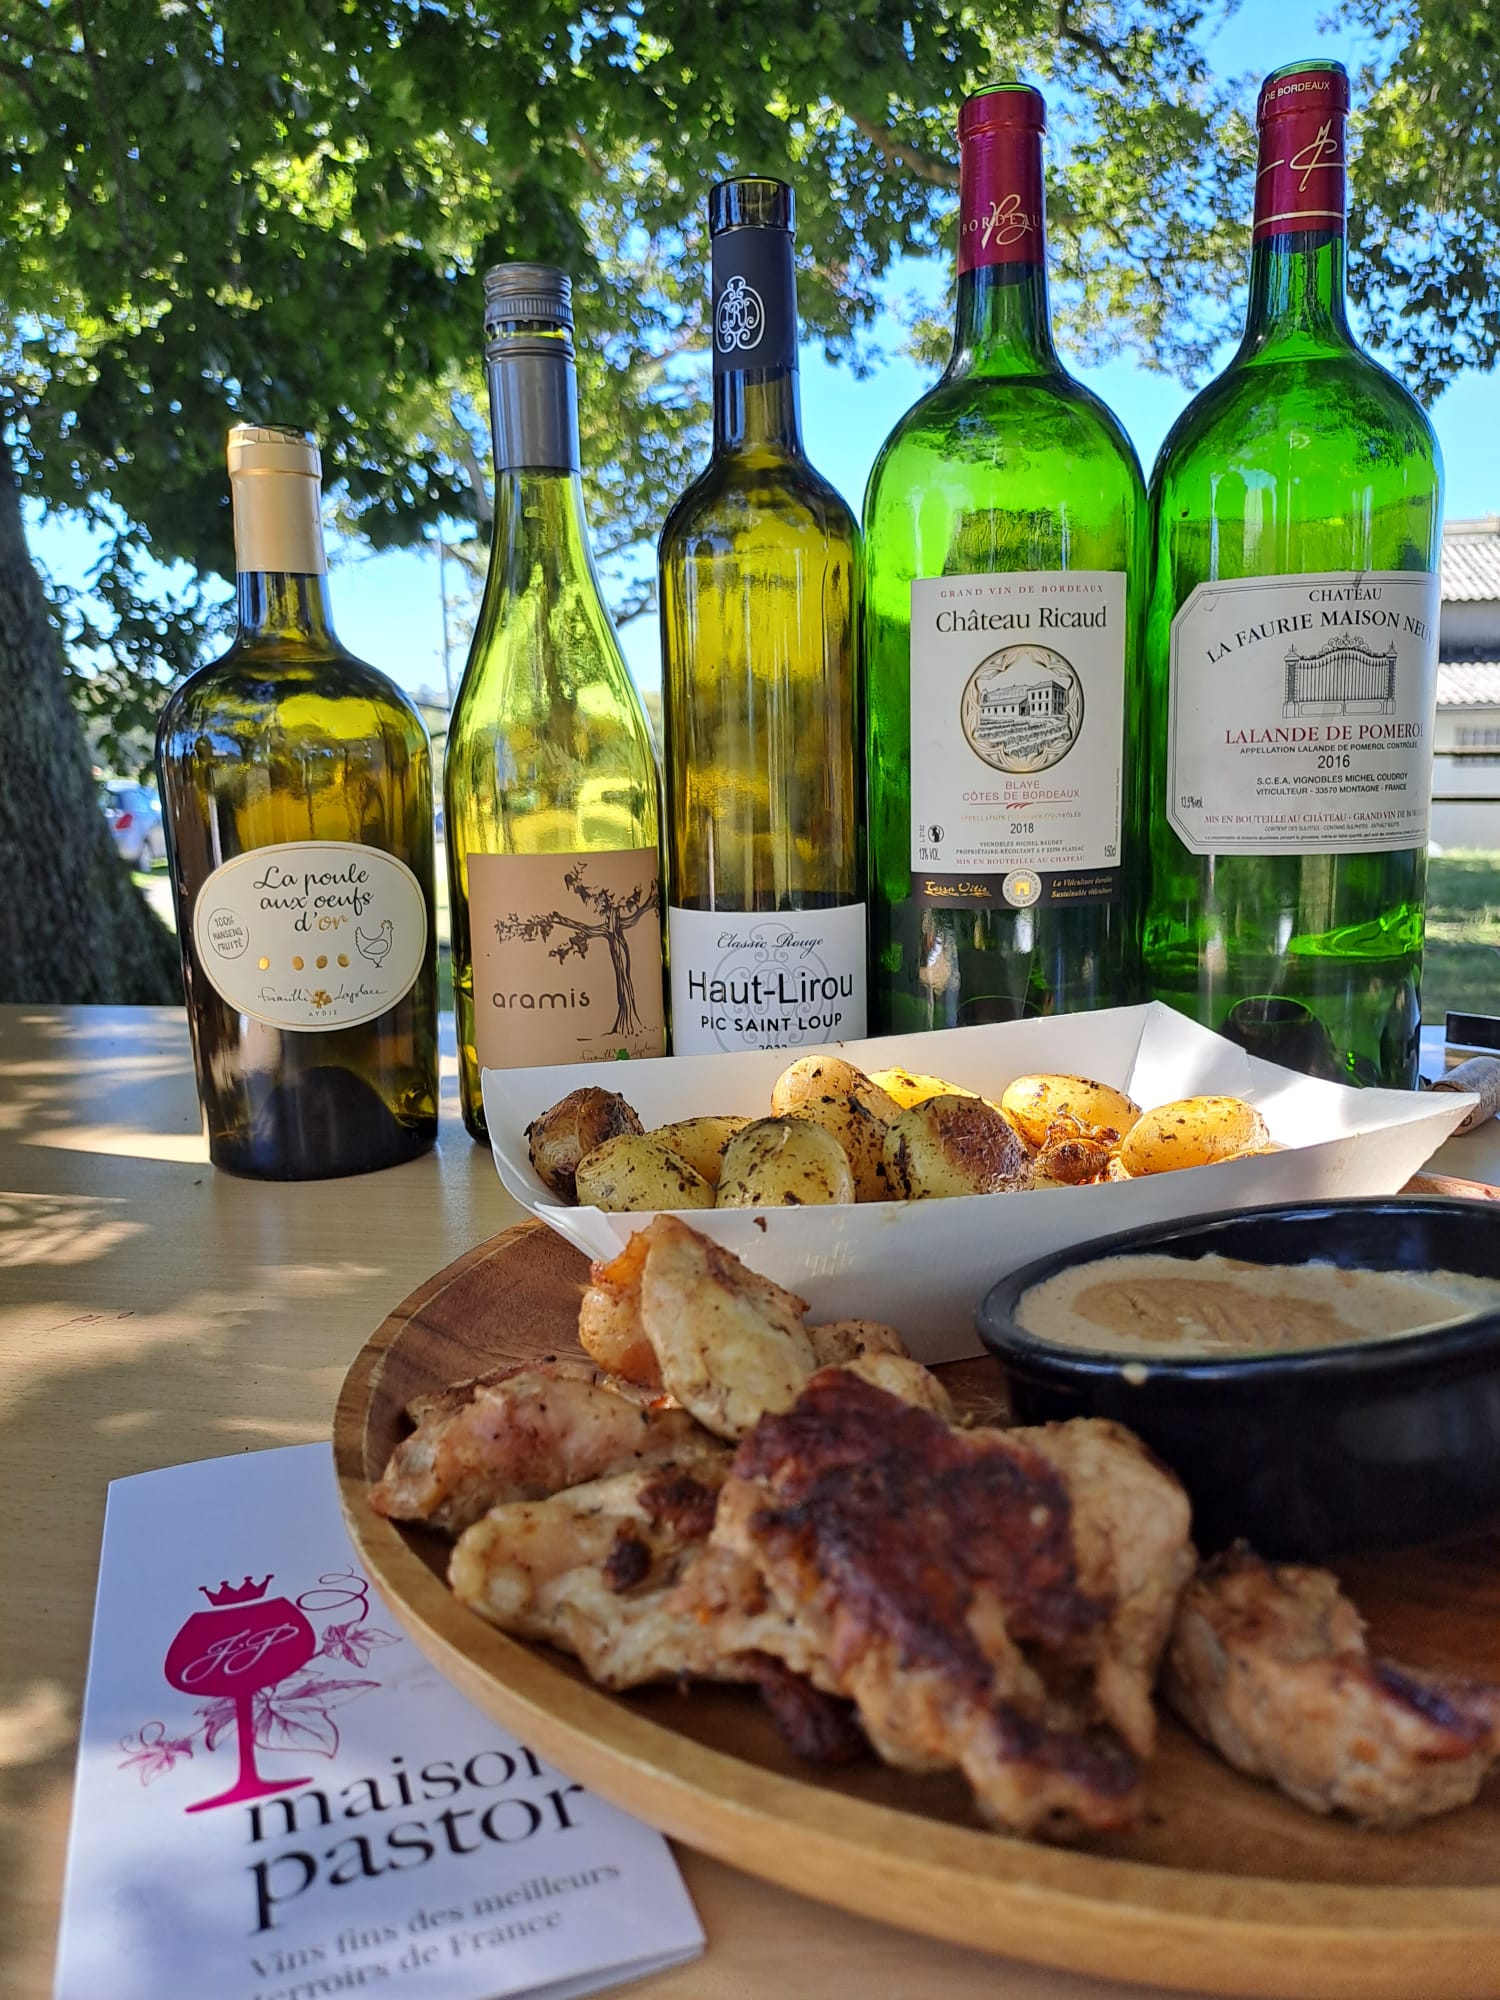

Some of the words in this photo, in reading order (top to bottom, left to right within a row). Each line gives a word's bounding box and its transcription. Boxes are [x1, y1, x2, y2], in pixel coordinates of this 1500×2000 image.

[1278, 82, 1330, 97] BORDEAUX
[940, 588, 983, 598] GRAND
[989, 587, 1012, 595] VIN
[1018, 586, 1035, 594] DE
[1042, 584, 1104, 594] BORDEAUX
[1309, 588, 1382, 602] CHATEAU
[936, 608, 1030, 632] Château
[1038, 606, 1108, 628] Ricaud
[1206, 642, 1232, 664] LA
[1234, 614, 1313, 648] FAURIE
[1320, 610, 1400, 628] MAISON
[1225, 726, 1320, 744] LALANDE
[1326, 726, 1352, 741] DE
[1240, 746, 1294, 754] APPELLATION
[1318, 754, 1350, 768] 2016
[1005, 780, 1040, 790] BLAYE
[1257, 777, 1290, 785] S.C.E.A.
[1292, 776, 1343, 784] VIGNOBLES
[1345, 774, 1376, 782] MICHEL
[962, 790, 1000, 802] CÔTES
[1004, 792, 1018, 800] DE
[1022, 790, 1080, 800] BORDEAUX
[1256, 788, 1308, 796] VITICULTEUR
[1339, 785, 1380, 793] MONTAGNE
[1384, 784, 1407, 792] FRANCE
[1205, 816, 1219, 824] MIS
[1222, 816, 1233, 824] EN
[1236, 816, 1286, 824] BOUTEILLE
[1353, 812, 1382, 820] GRAND
[1384, 811, 1396, 819] VIN
[1010, 822, 1034, 834] 2018
[253, 866, 298, 889] La
[303, 864, 368, 896] poule
[260, 896, 307, 910] aux
[314, 887, 374, 916] oeufs
[214, 915, 234, 927] 100%
[717, 932, 767, 948] Classic
[772, 932, 824, 959] Rouge
[688, 970, 852, 1004] Haut-Lirou
[492, 988, 590, 1010] aramis
[702, 1016, 726, 1030] PIC
[734, 1018, 791, 1032] SAINT
[798, 1012, 842, 1030] LOUP
[246, 1784, 585, 1938] pastor
[250, 1941, 326, 1979] Vins
[336, 1927, 399, 1956] fins
[407, 1907, 464, 1936] des
[472, 1861, 622, 1917] meilleurs
[400, 1943, 440, 1972] de
[449, 1910, 564, 1959] France
